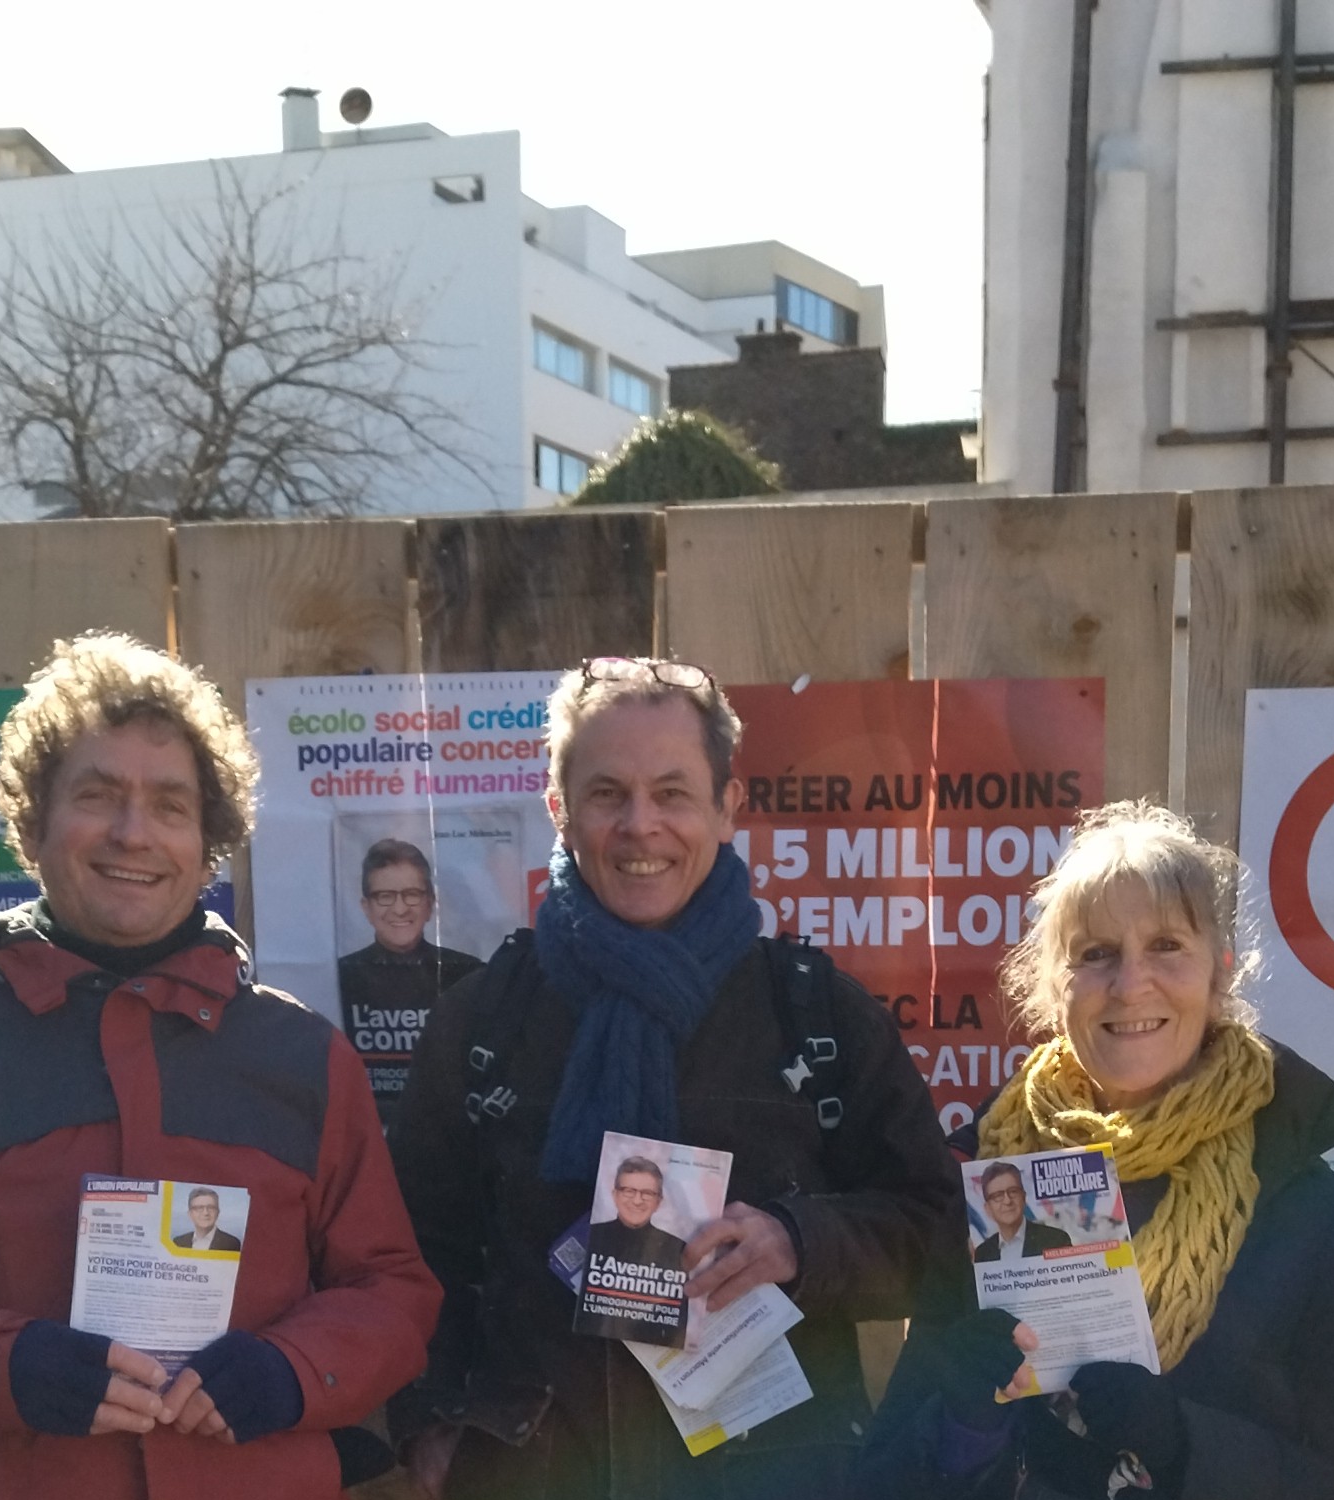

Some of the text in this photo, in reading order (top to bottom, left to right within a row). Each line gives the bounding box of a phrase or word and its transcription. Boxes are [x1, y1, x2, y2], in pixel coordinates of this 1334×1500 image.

[288, 702, 548, 735] écolo social crédi
[298, 735, 549, 771] populaire concer
[310, 766, 550, 796] chiffré humanist
[747, 767, 1082, 813] RÉER AU MOINS
[933, 995, 984, 1030] LA
[1033, 1157, 1084, 1180] L'UNION
[1036, 1171, 1105, 1198] POPULAIRE
[87, 1256, 125, 1267] VOTONS
[126, 1259, 152, 1270] POUR
[87, 1264, 97, 1274] LE
[154, 1270, 173, 1280] DES
[175, 1272, 209, 1284] RICHES
[589, 1252, 686, 1283] L'Avenir en
[982, 1260, 1097, 1281] Avec l'Avenir en commun,
[588, 1270, 685, 1299] commun
[983, 1282, 1012, 1293] l'Union
[1013, 1278, 1059, 1291] Populaire
[1060, 1275, 1075, 1284] est
[1077, 1267, 1118, 1284] possible
[583, 1302, 679, 1327] L'UNION POPULAIRE
[584, 1293, 680, 1317] LE PROGRAMME POUR
[680, 1355, 709, 1383] Macron
